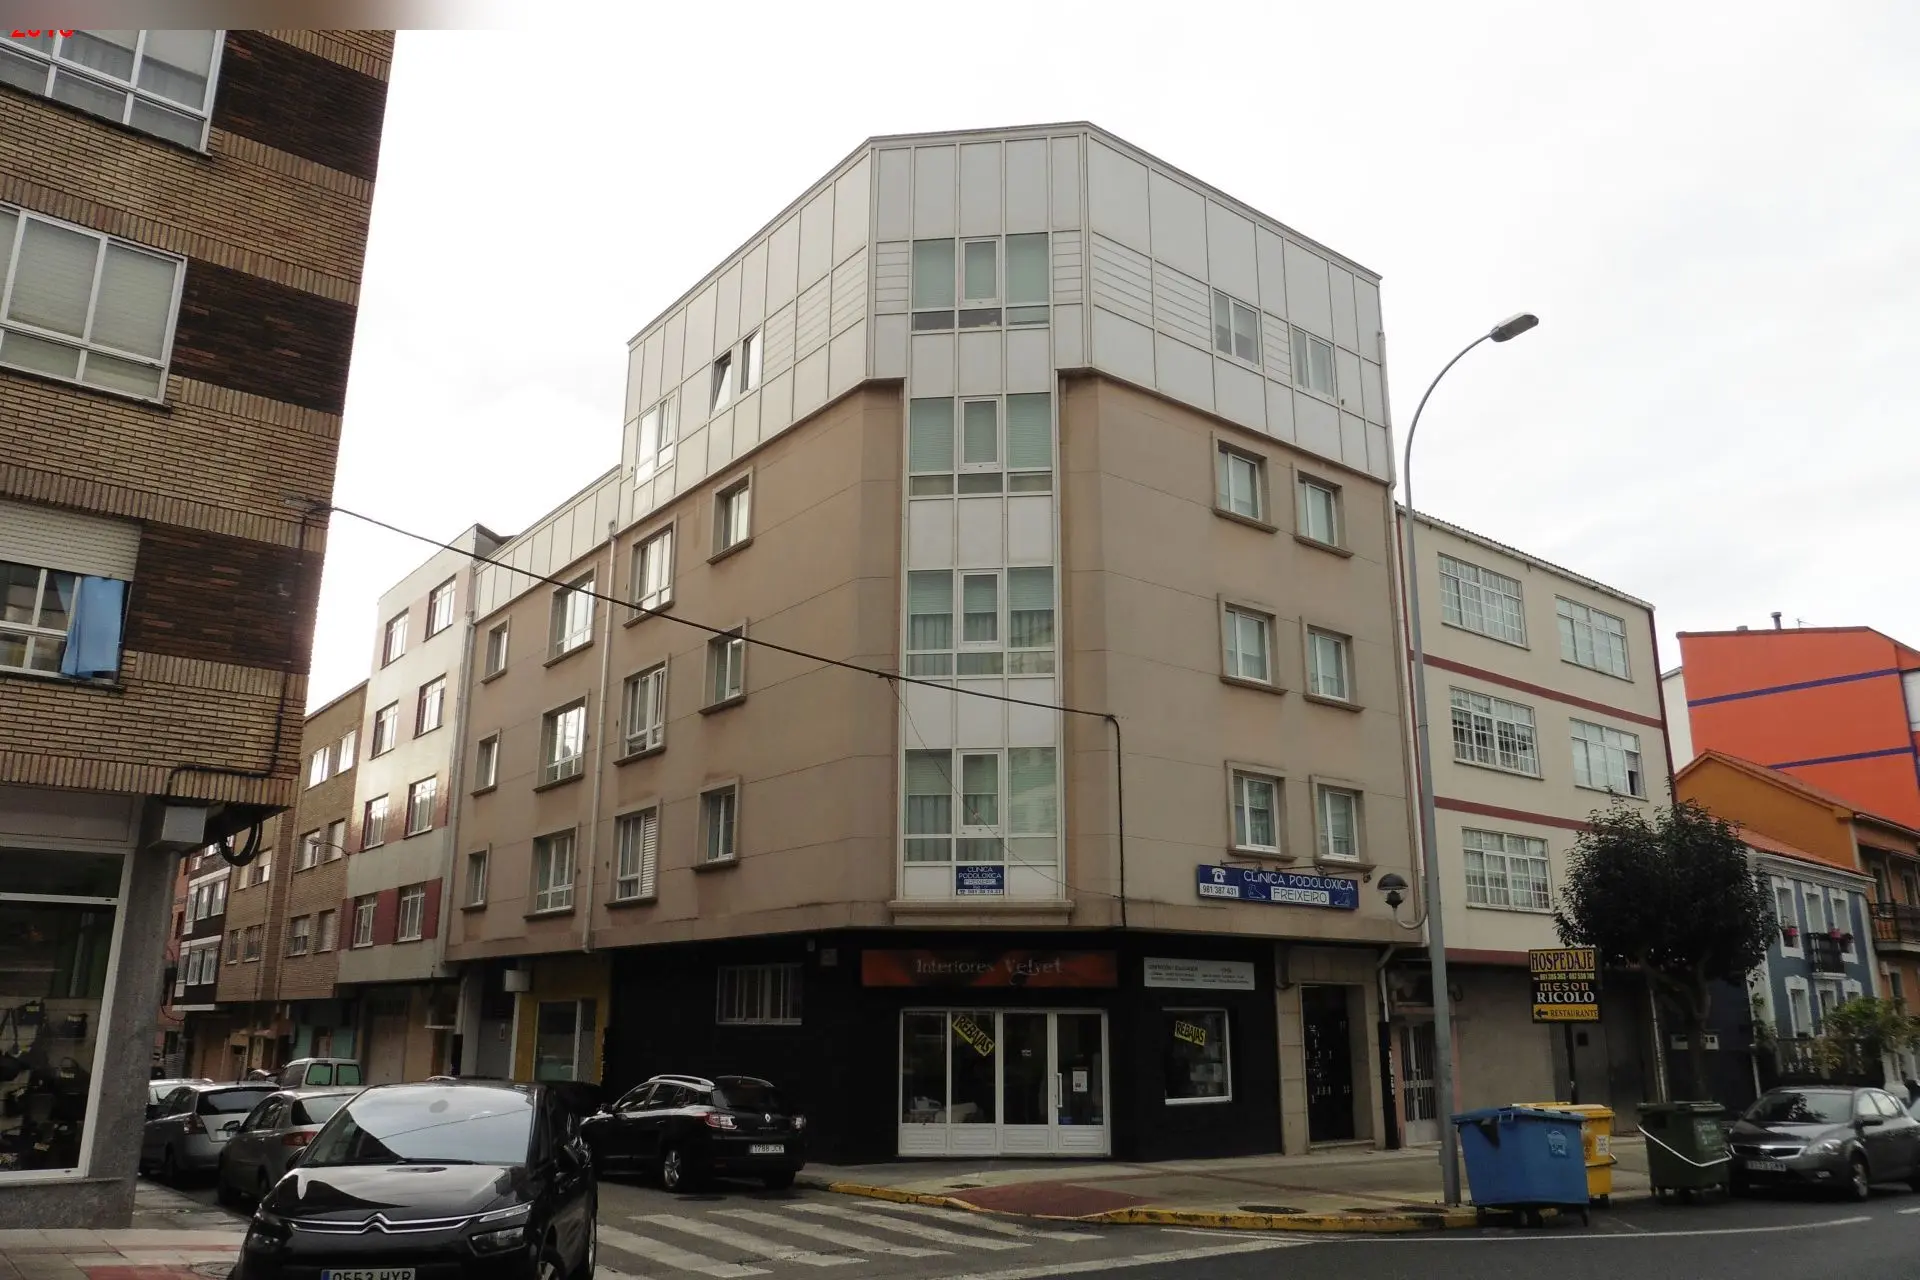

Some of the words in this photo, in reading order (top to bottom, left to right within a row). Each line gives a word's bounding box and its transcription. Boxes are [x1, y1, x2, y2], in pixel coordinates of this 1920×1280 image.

[1202, 885, 1214, 894] 981
[1214, 886, 1225, 895] 387
[1226, 888, 1237, 896] 431
[1288, 874, 1354, 891] PODOLOXICA
[1273, 889, 1328, 903] FREIXEIRO
[1531, 952, 1594, 970] HOSPEDAJE
[916, 958, 994, 974] Interiores
[1005, 958, 1063, 983] Velvet
[1537, 991, 1595, 1003] RICOLO
[955, 1016, 994, 1054] REBAJAS
[1176, 1022, 1205, 1044] REBAJAS
